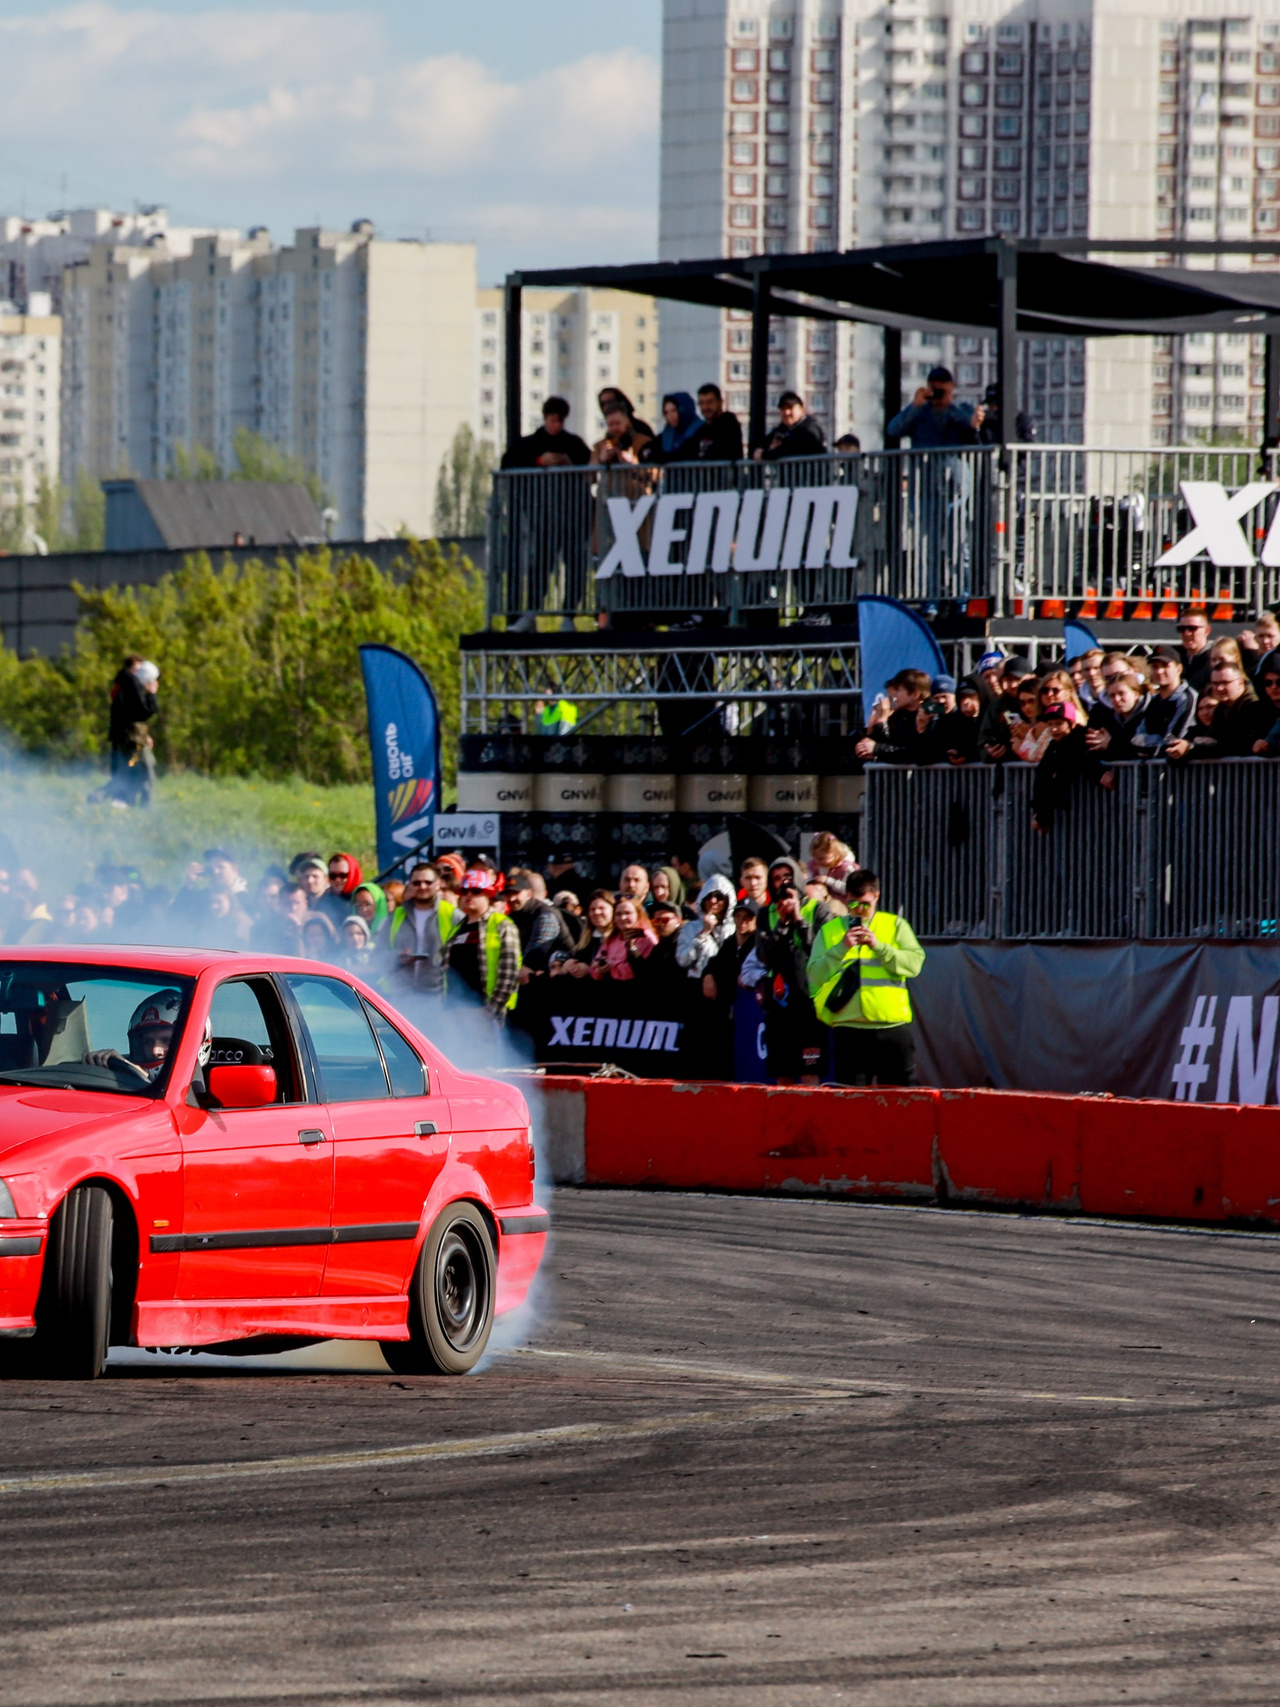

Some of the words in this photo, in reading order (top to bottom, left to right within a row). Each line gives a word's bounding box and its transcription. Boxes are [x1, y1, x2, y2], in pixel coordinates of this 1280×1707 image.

[595, 485, 859, 579] XENUM
[1154, 481, 1280, 566] X
[438, 827, 468, 839] GNV
[211, 1050, 243, 1061] arco
[547, 1016, 680, 1051] XENUM
[1172, 995, 1280, 1105] #N
